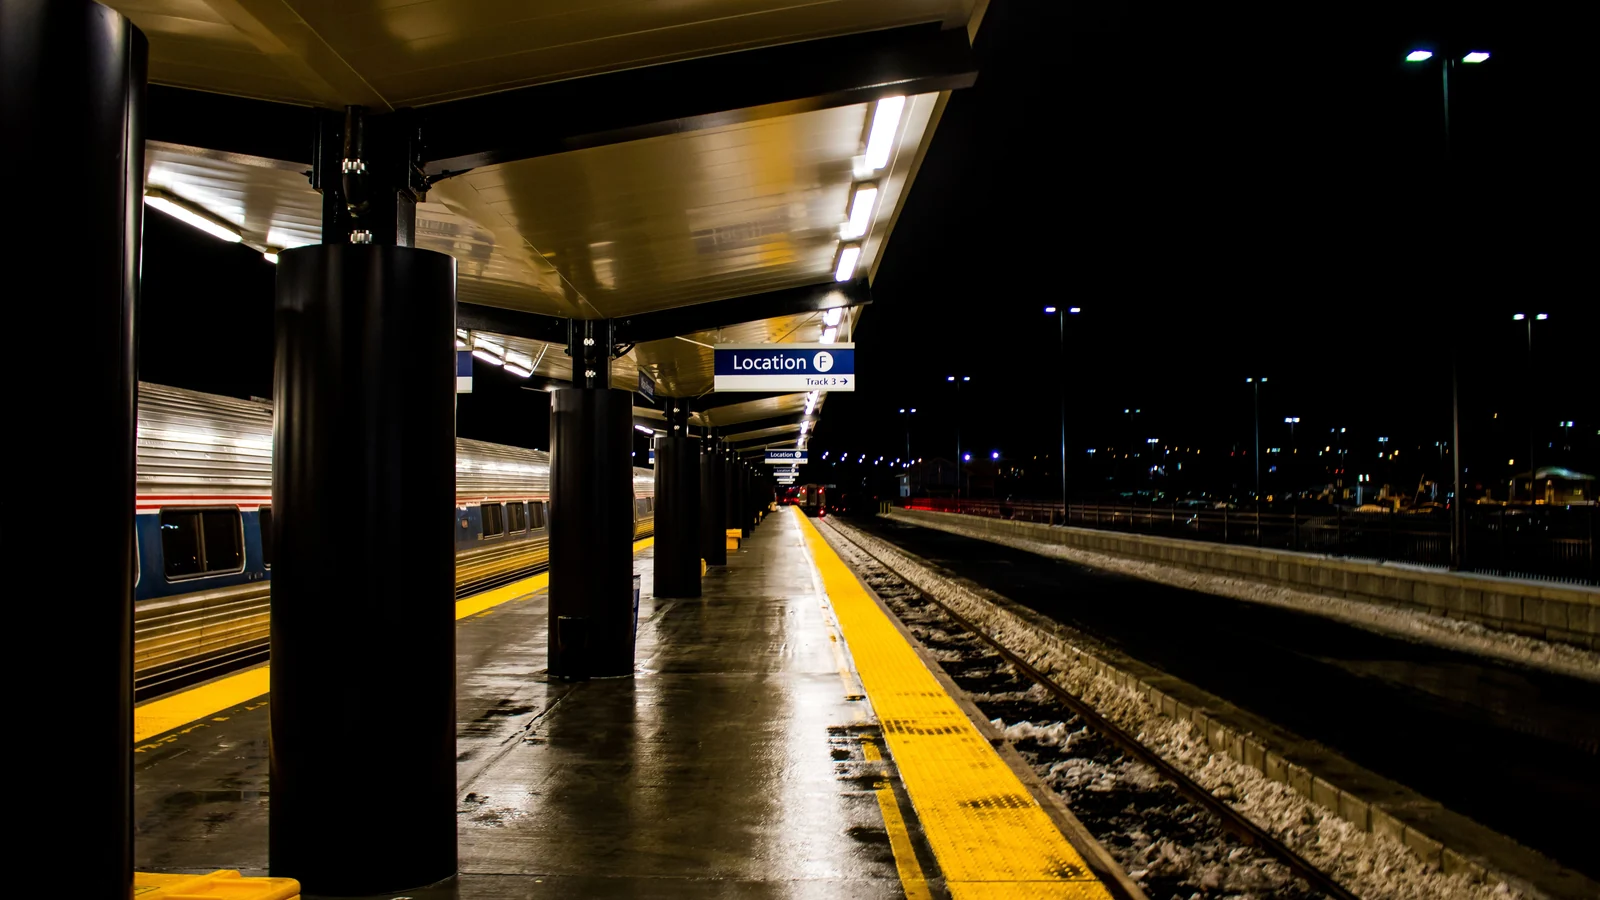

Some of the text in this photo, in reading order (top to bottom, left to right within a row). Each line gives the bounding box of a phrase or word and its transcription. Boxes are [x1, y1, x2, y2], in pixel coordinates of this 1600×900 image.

[733, 354, 827, 370] Location F
[805, 377, 837, 386] Track 3
